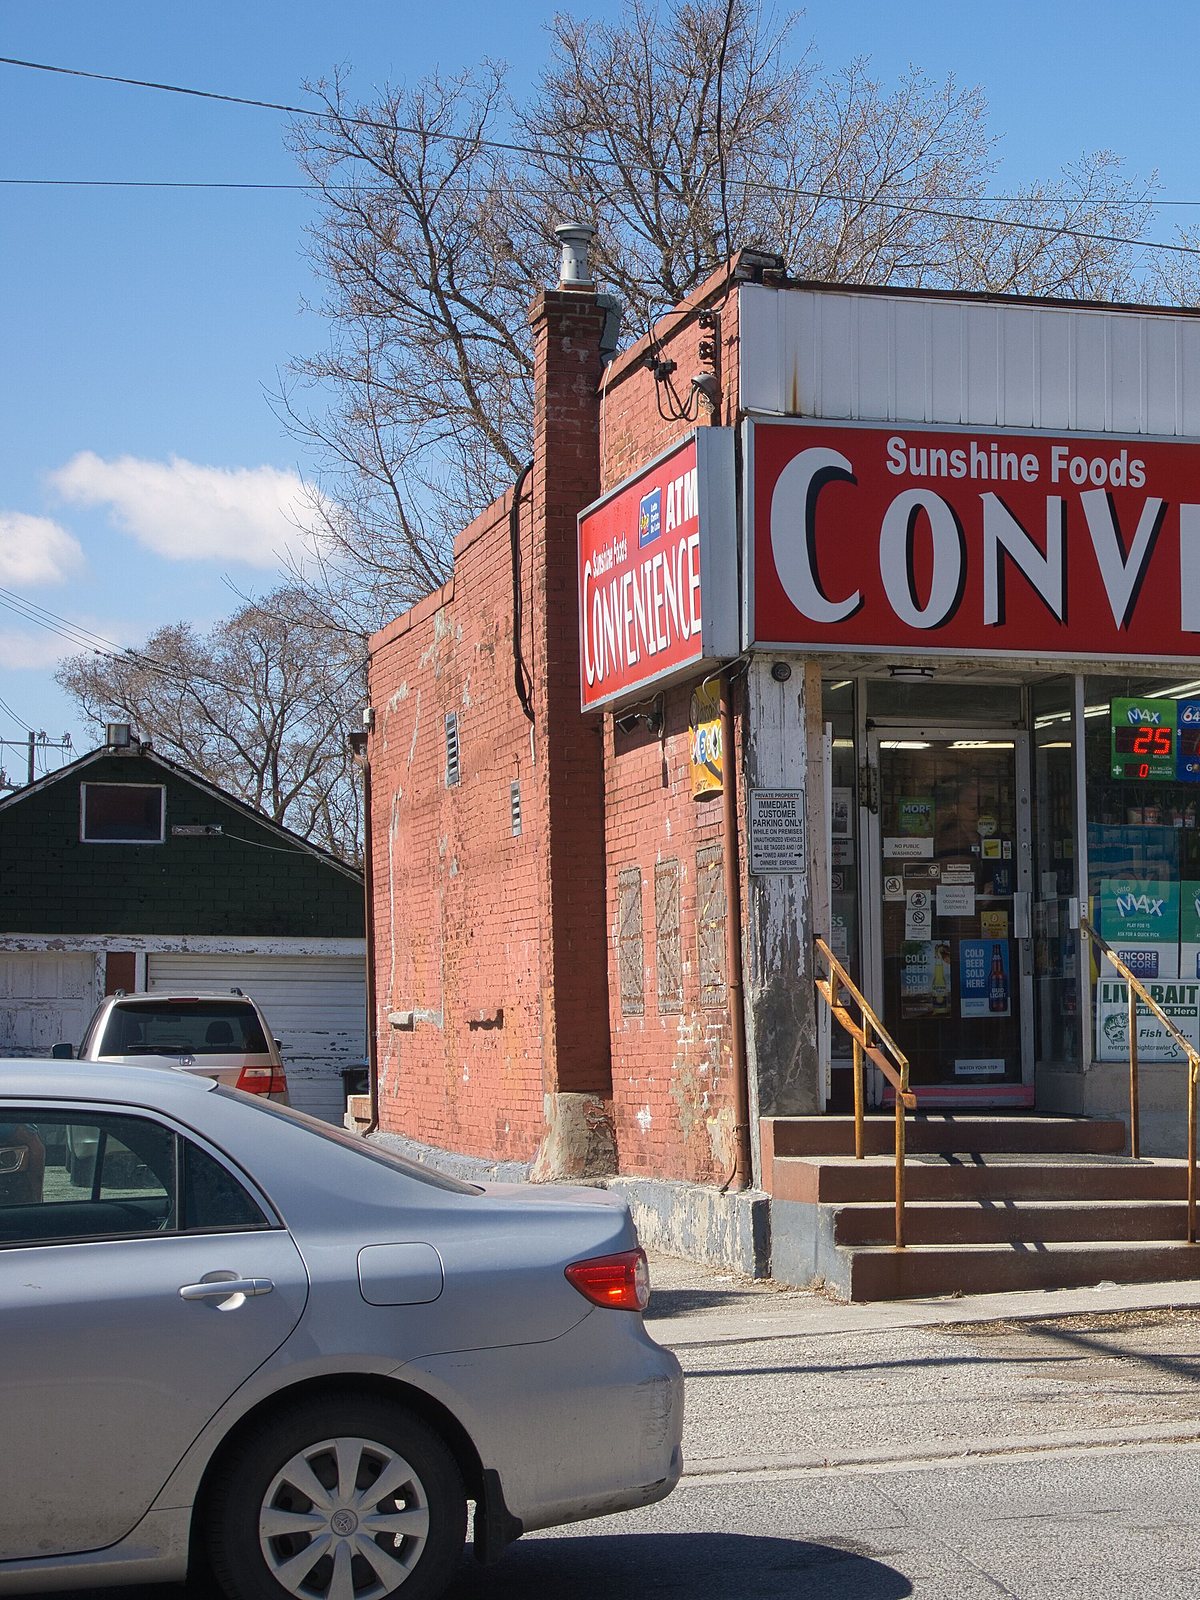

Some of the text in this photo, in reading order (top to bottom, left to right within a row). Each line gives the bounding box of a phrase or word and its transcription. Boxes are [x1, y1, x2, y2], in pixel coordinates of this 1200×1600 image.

[886, 437, 1146, 488] Sunshine Foods
[666, 468, 699, 533] ATM
[593, 532, 628, 578] Sunshine Foods
[584, 532, 702, 686] CONVENIENCE
[1127, 708, 1160, 724] MAX
[1134, 727, 1170, 754] 25
[1139, 764, 1148, 778] 0
[1116, 893, 1163, 917] MAX
[906, 955, 928, 963] COLD
[965, 949, 984, 958] COLD
[1120, 952, 1157, 960] ENCORE
[906, 965, 928, 973] BEER
[966, 970, 984, 978] SOLD
[906, 975, 928, 984] SOLD
[966, 979, 984, 988] HERE
[1150, 984, 1199, 1004] BAIT
[1140, 1029, 1162, 1038] Fish
